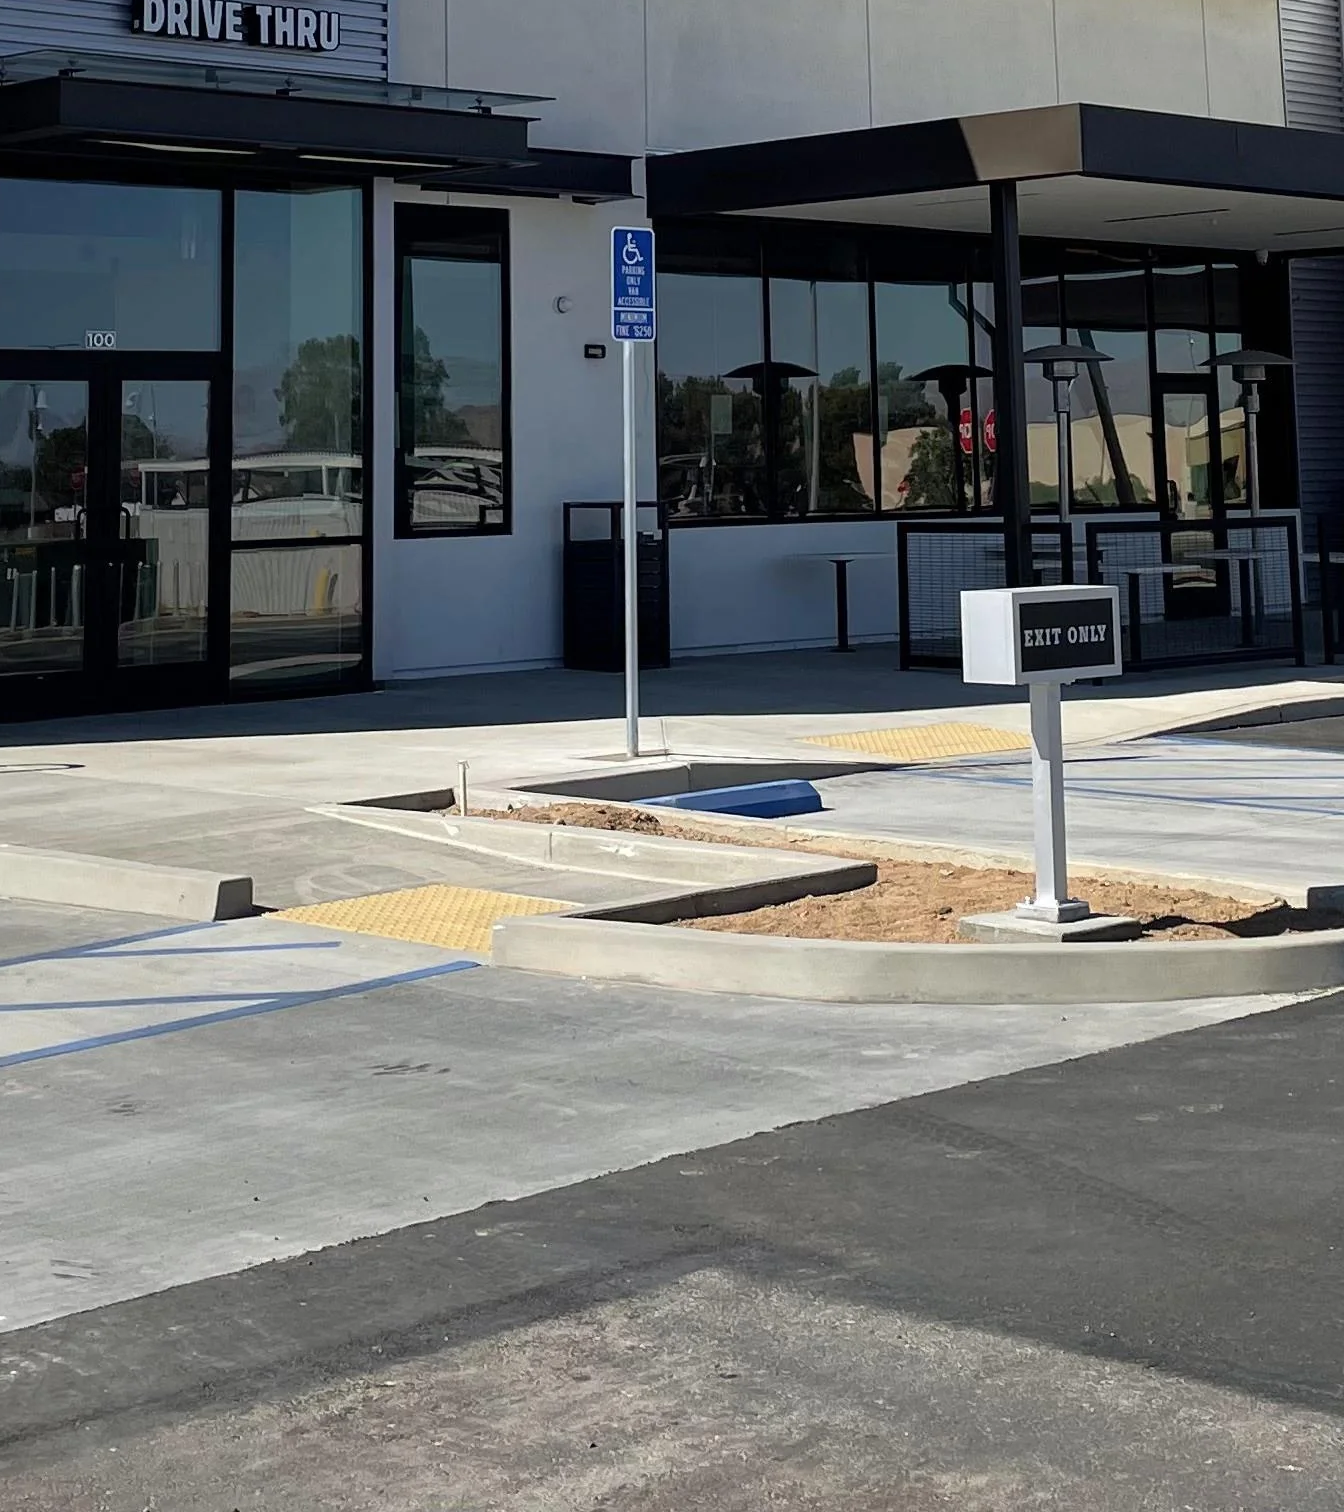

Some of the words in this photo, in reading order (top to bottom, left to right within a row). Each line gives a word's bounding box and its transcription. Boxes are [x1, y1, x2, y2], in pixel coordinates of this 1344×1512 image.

[256, 5, 339, 51] THRU
[621, 265, 645, 276] PARKING
[626, 276, 641, 286] ONLY
[628, 286, 639, 296] VAN
[617, 296, 650, 307] ACCESSIBLE
[616, 325, 630, 337] FINE
[87, 333, 114, 347] 100
[1024, 627, 1061, 647] EXIT
[1067, 624, 1107, 644] ONLY
